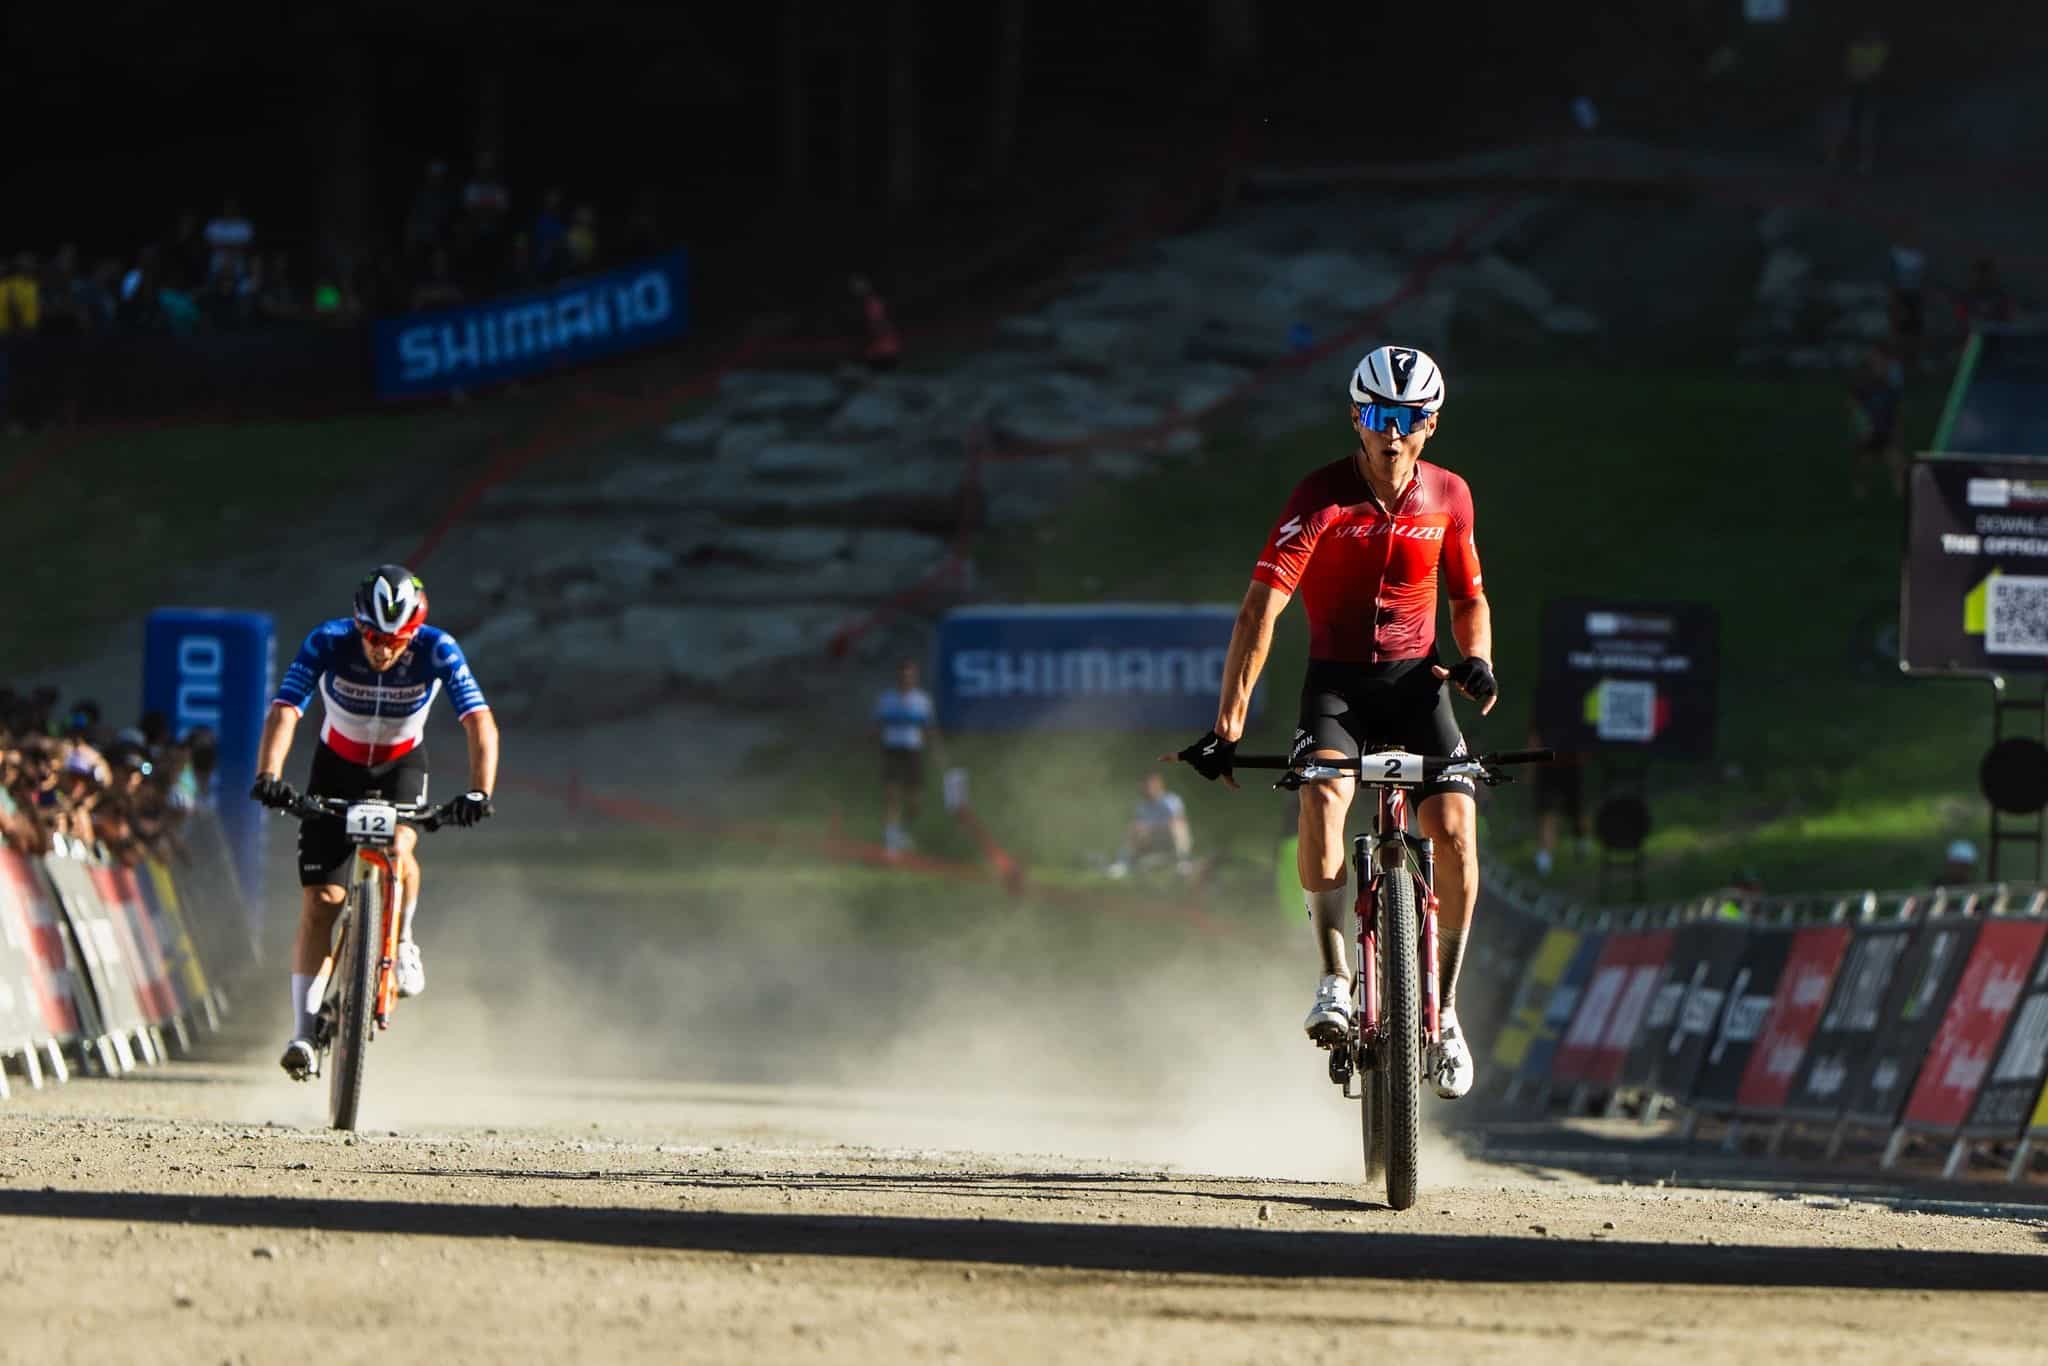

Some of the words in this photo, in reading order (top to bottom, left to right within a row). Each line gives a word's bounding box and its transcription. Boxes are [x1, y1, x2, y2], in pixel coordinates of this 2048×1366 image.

[398, 270, 672, 381] SHIMANO
[1383, 758, 1403, 779] 2
[358, 815, 387, 832] 12
